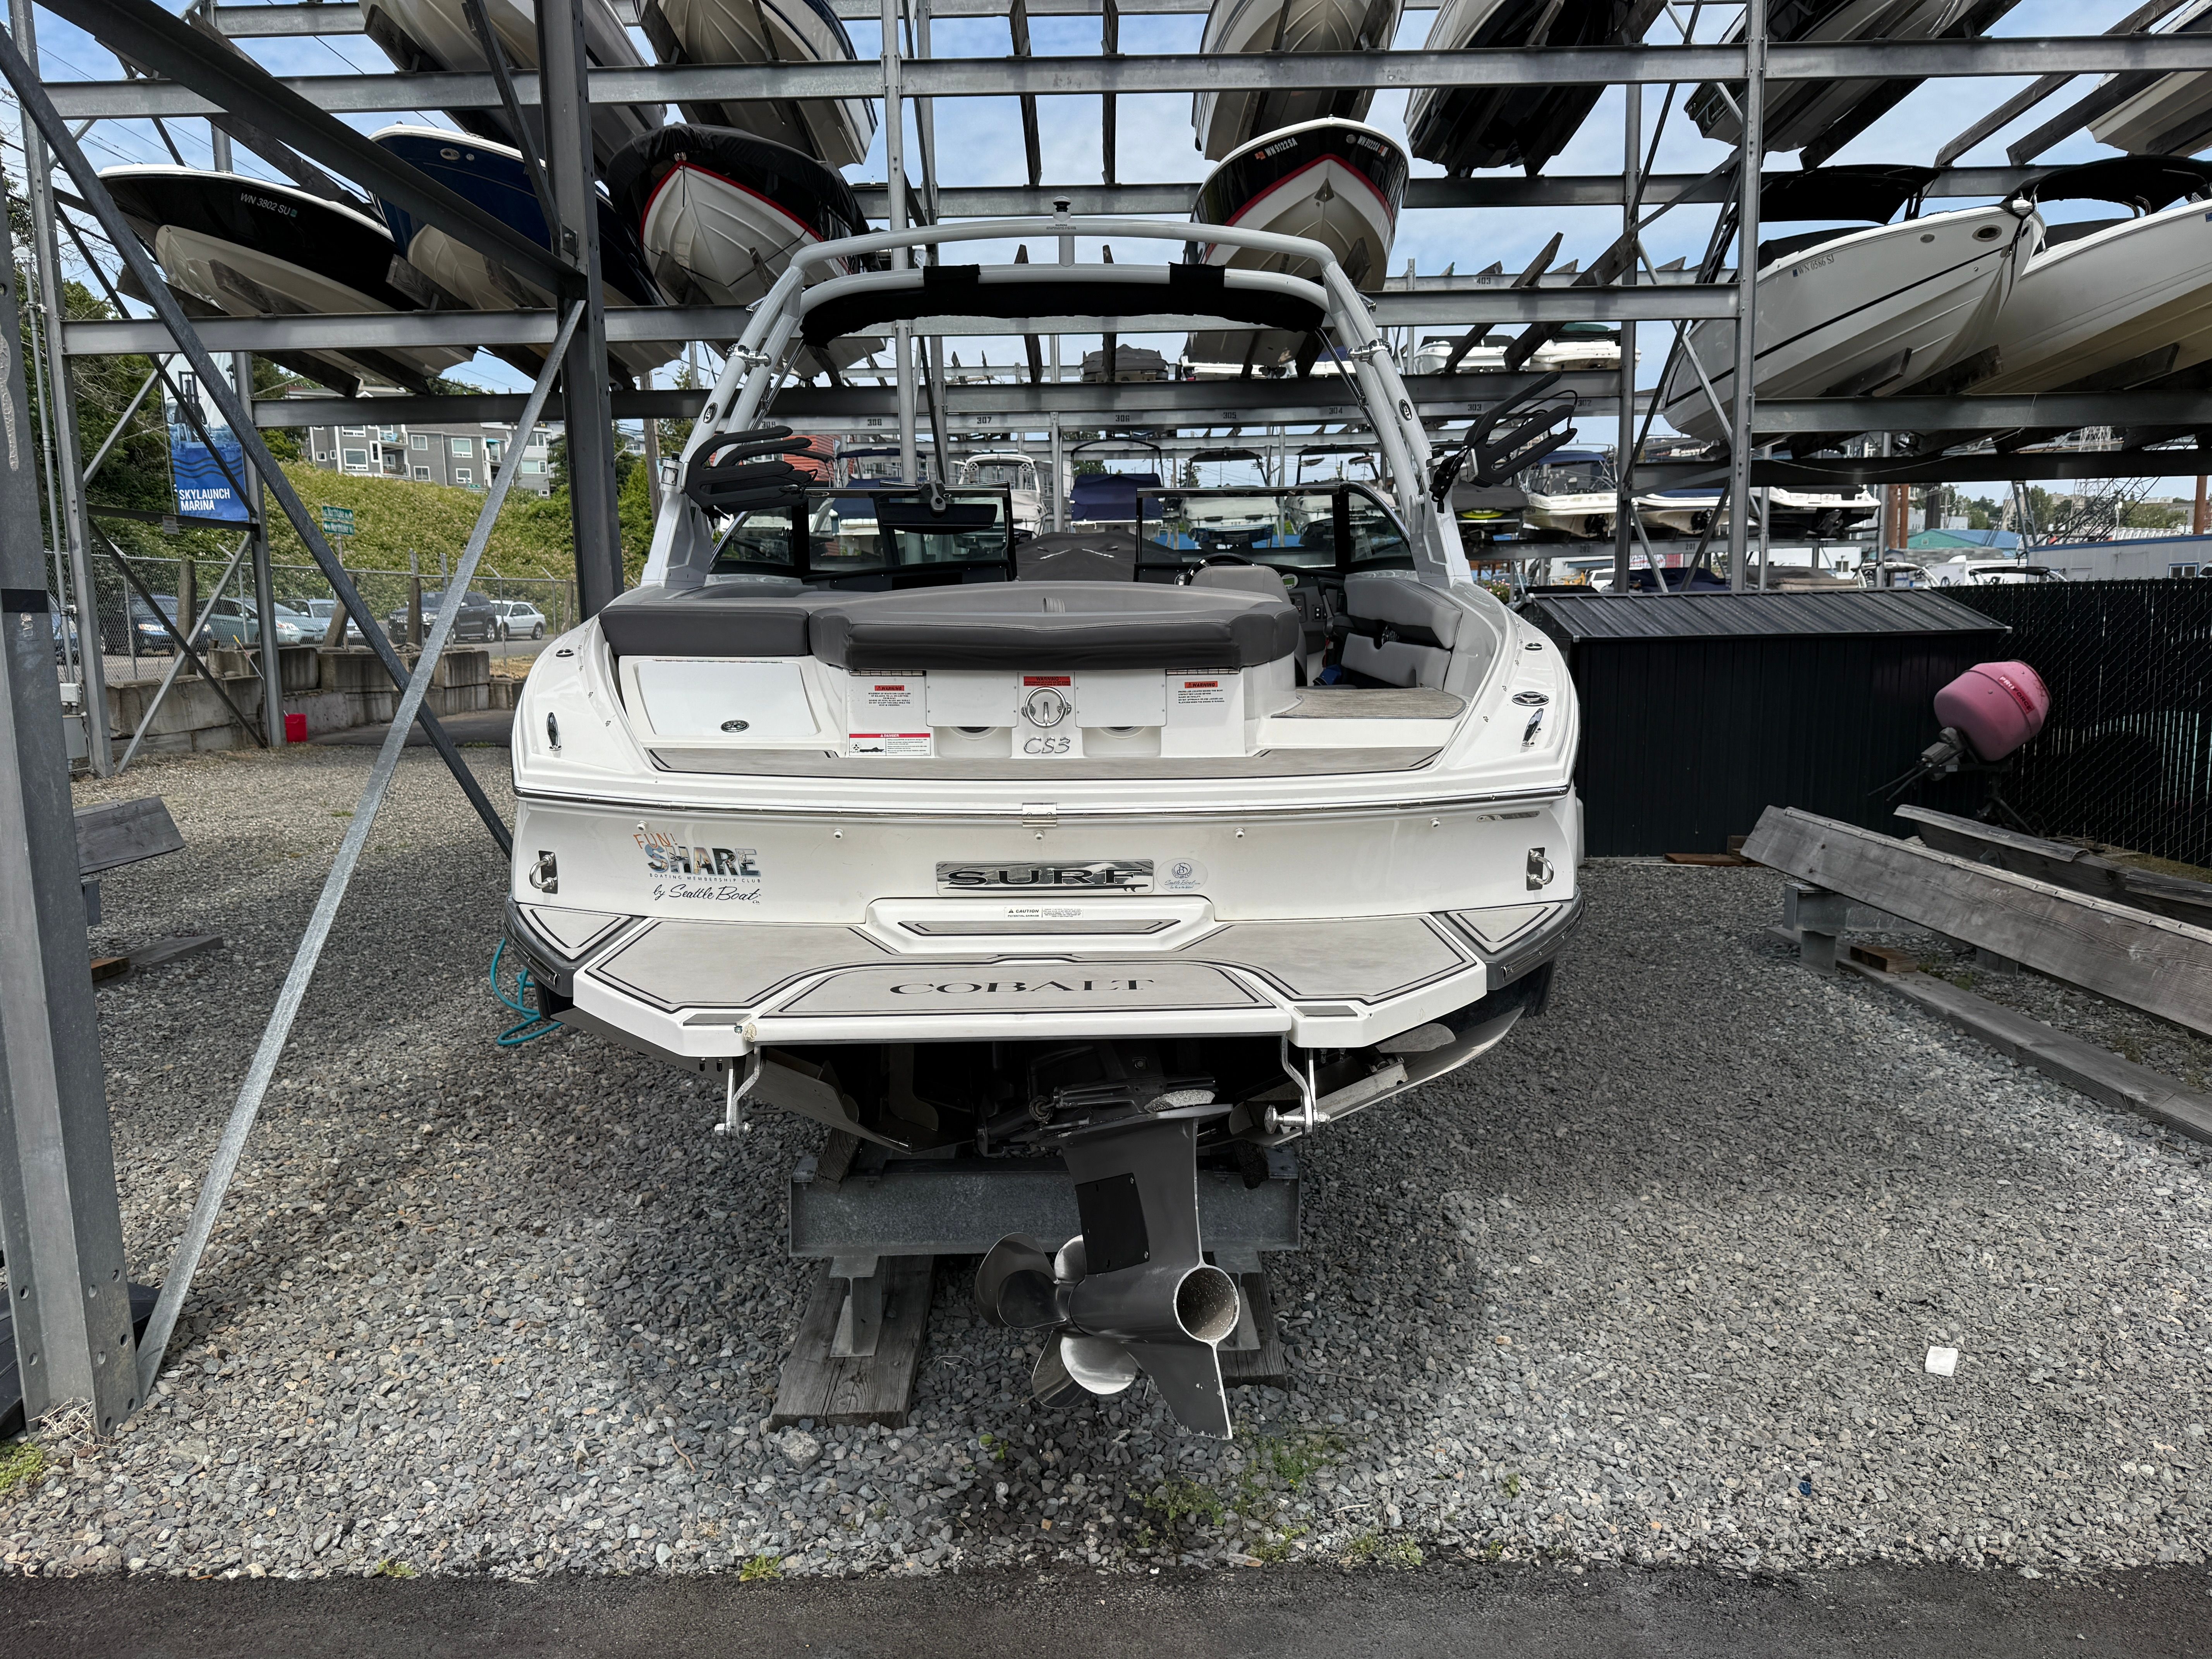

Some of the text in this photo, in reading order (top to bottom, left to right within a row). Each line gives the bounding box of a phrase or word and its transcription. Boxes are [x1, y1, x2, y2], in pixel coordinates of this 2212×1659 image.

[240, 193, 290, 215] WN 3802 SU
[1798, 254, 1834, 274] WN 0586 SJ
[179, 488, 230, 500] SKYLAUNCH
[180, 500, 215, 511] MARINA
[1999, 676, 2032, 710] PROFORCE
[1024, 737, 1070, 754] CS3
[633, 833, 678, 849] FUN!
[645, 843, 761, 877] SHARE
[948, 868, 1143, 885] SURF
[653, 884, 665, 900] by
[669, 884, 714, 898] Seattle
[890, 980, 1154, 994] COBALT
